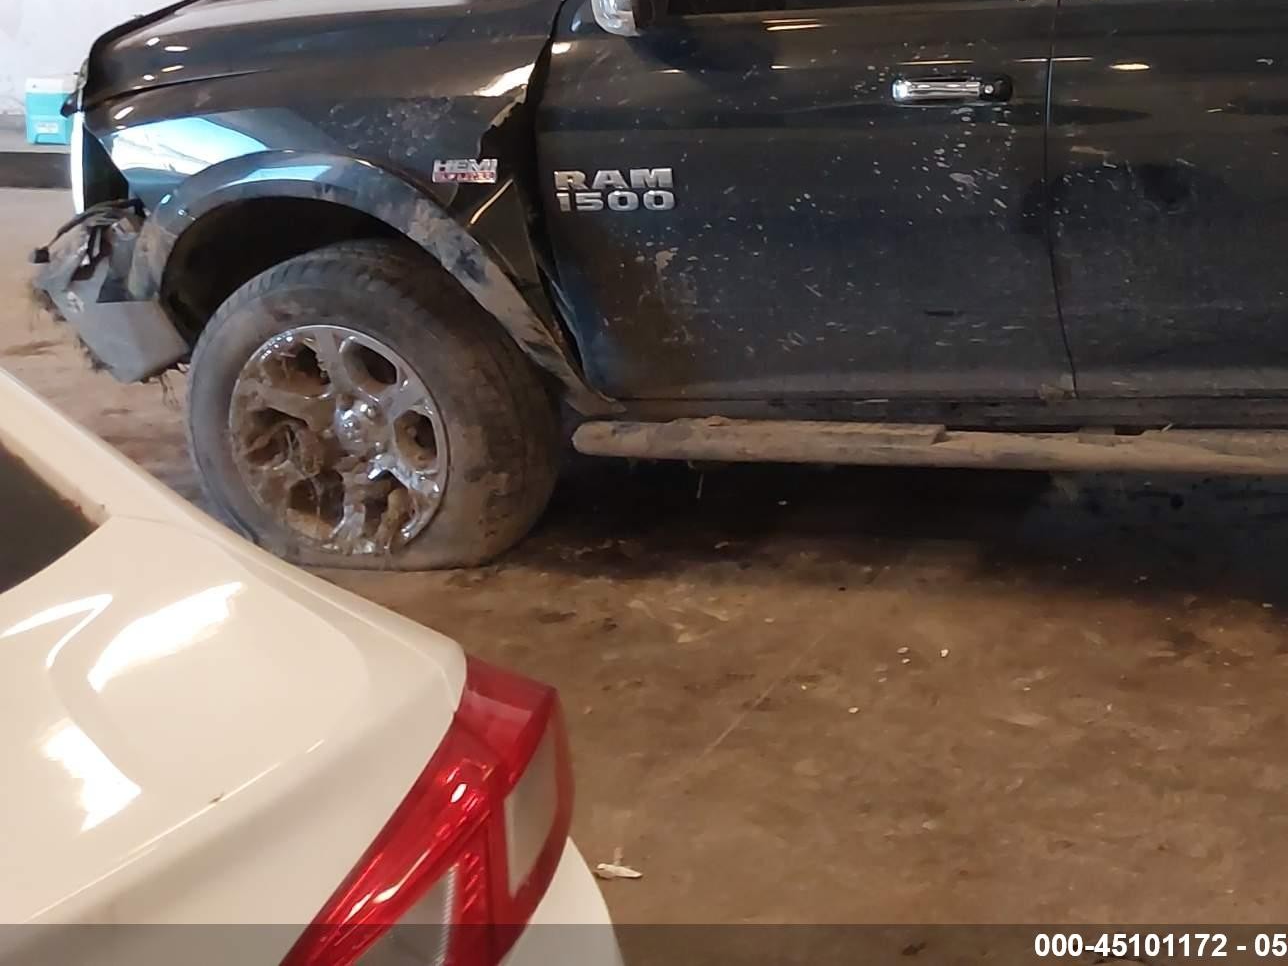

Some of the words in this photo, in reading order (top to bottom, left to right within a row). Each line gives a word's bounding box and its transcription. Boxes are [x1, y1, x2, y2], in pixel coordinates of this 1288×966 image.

[433, 158, 498, 172] HEMI
[553, 168, 673, 190] RAM
[556, 190, 675, 212] 1500
